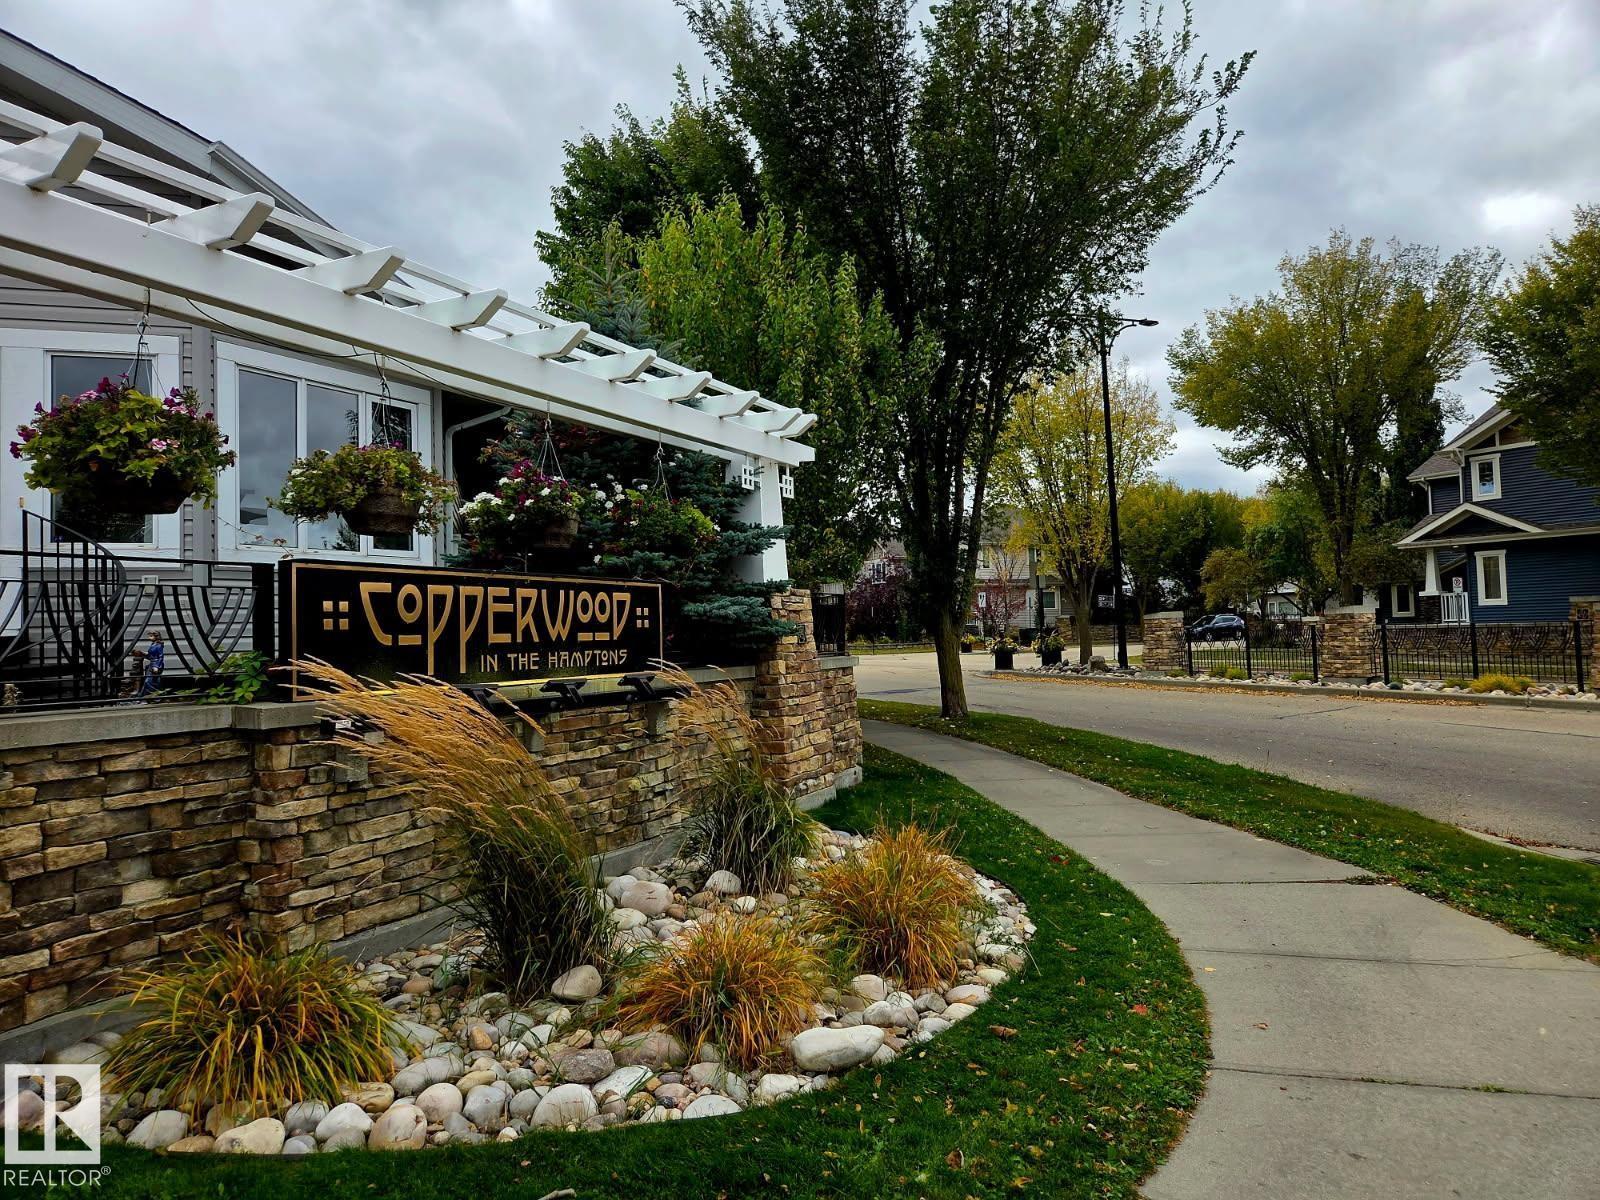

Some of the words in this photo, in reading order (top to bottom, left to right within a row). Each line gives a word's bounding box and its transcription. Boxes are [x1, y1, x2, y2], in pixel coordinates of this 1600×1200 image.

[359, 582, 632, 676] COPPERWOOD
[480, 654, 498, 673] IN
[507, 652, 539, 671] THE
[548, 649, 628, 669] HAMPTONS
